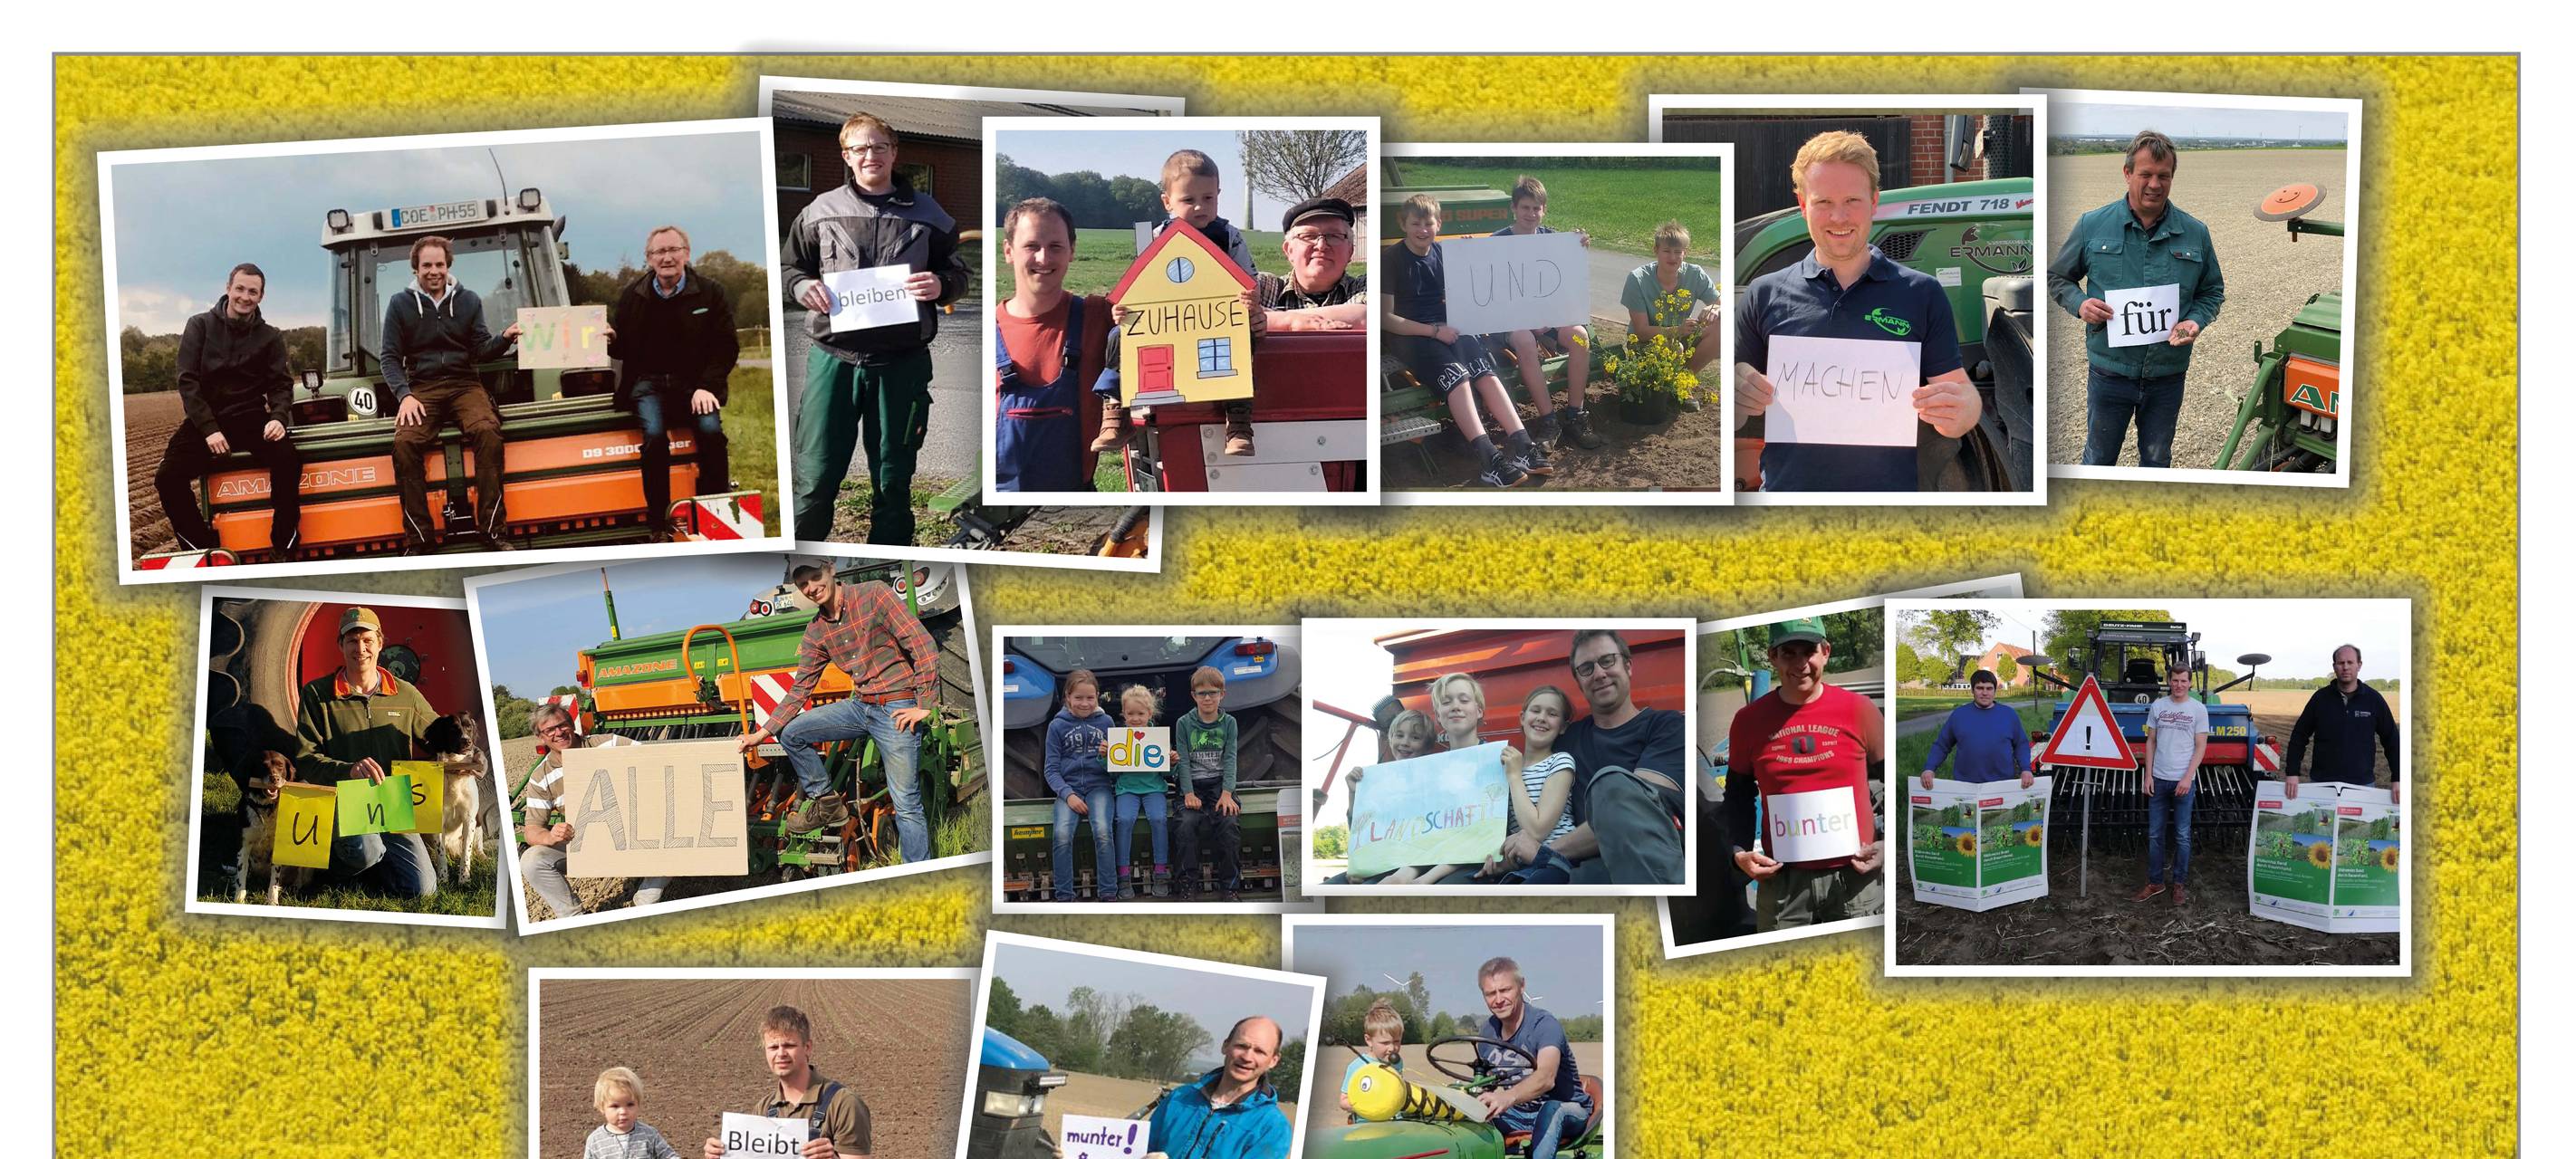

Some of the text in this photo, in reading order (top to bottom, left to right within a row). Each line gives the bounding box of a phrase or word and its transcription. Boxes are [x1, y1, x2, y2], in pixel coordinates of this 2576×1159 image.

[400, 208, 428, 225] COE
[1456, 207, 1508, 221] SUPER
[1908, 200, 1972, 215] FENDT
[1980, 198, 2010, 211] 718
[1470, 259, 1562, 307] UND
[838, 287, 907, 307] bleiben
[1127, 300, 1244, 336] ZUHAUSE
[2120, 301, 2172, 336] für
[1773, 361, 1904, 405] MACHEN
[354, 391, 373, 410] 40
[216, 465, 376, 498] AMZONE
[597, 658, 678, 679] AMAZONE
[2137, 695, 2148, 704] 40
[1768, 724, 1840, 741] NATIONAL LEAGUE
[1110, 729, 1165, 769] die
[1793, 750, 1835, 764] CHAMPIONS
[570, 763, 739, 853] ALLE
[1370, 802, 1487, 842] LANDSCHAFT
[1774, 813, 1851, 838] bunter
[728, 1130, 800, 1155] Bleibt
